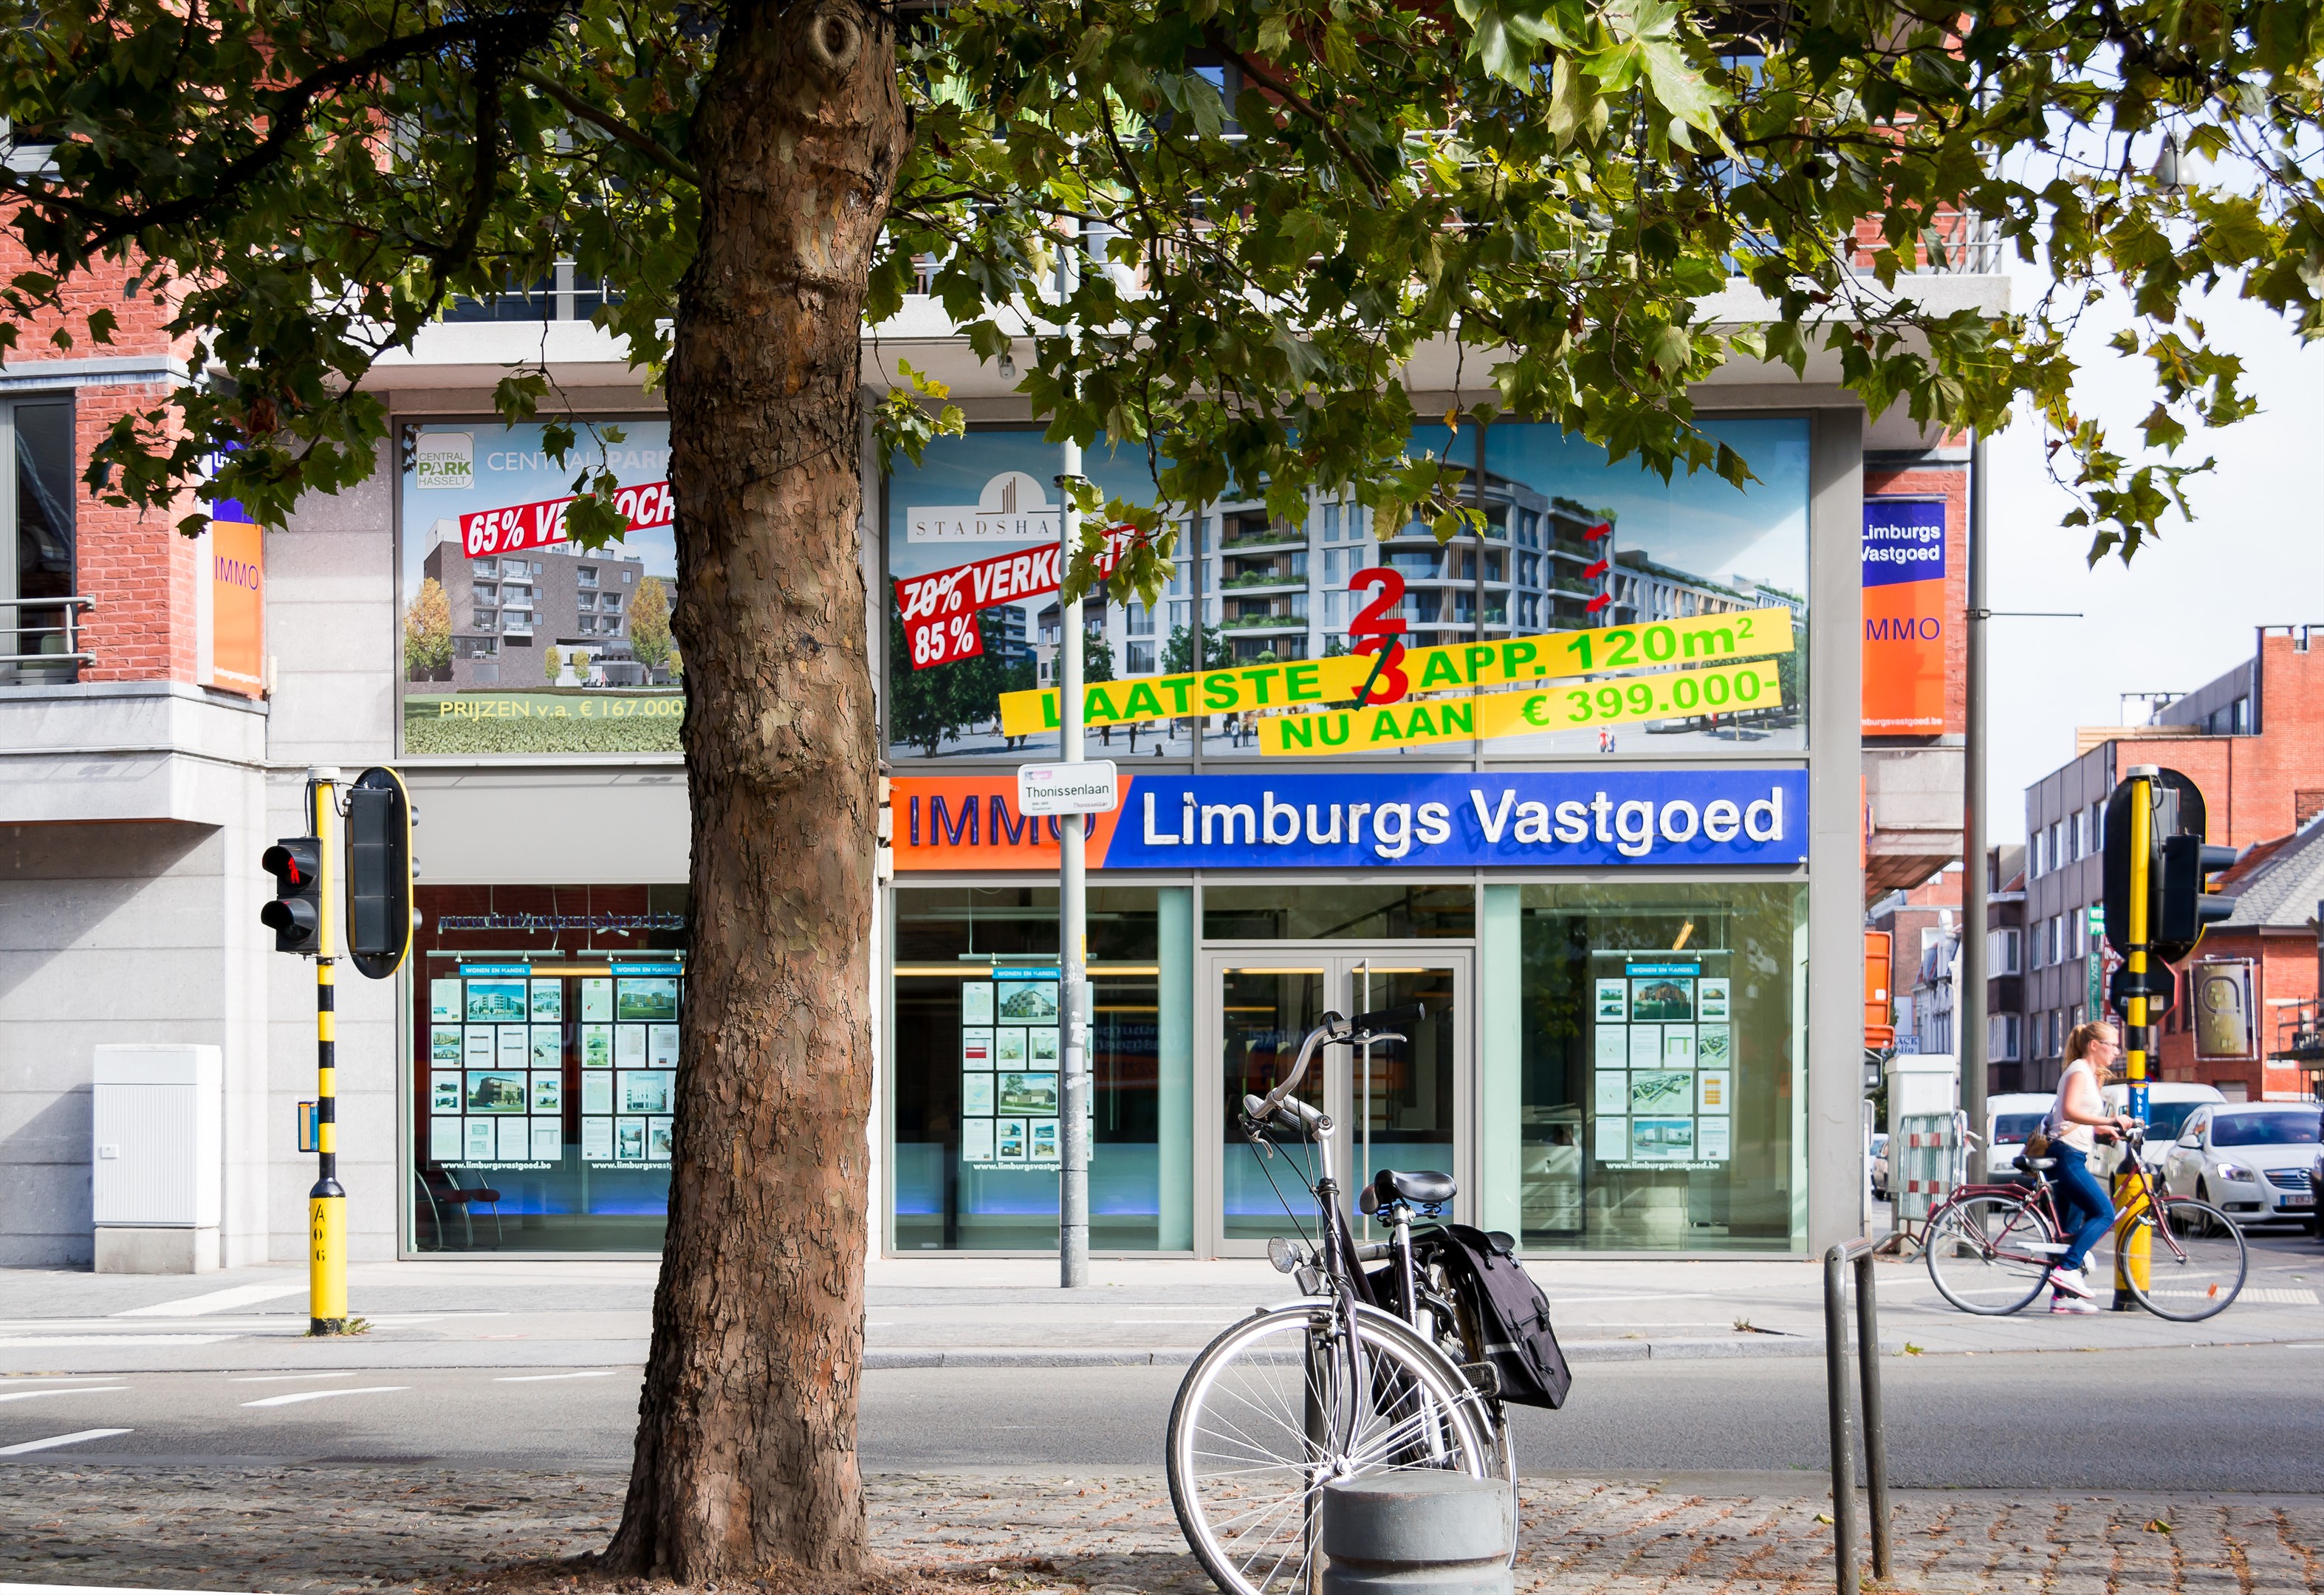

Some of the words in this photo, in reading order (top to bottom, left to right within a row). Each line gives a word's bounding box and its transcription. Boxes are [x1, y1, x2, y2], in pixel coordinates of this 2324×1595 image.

[419, 452, 466, 462] CENTRAL
[419, 462, 472, 476] PARK
[419, 476, 467, 486] HASSELT
[467, 507, 526, 555] 65%
[916, 518, 1091, 536] STADSHA
[214, 555, 259, 591] IMMO
[1348, 566, 1407, 637] 2
[1041, 664, 1323, 729] LAATSTE
[1419, 641, 1547, 688] APP.
[439, 701, 530, 722] PRIJZEN
[536, 704, 573, 717] v.a.
[578, 700, 594, 718] €
[602, 699, 685, 717] 167.000
[1280, 713, 1350, 750] NU
[1369, 702, 1474, 742] AAN
[1521, 694, 1550, 727] €
[1025, 783, 1110, 798] Thonissenlaan
[1143, 790, 1451, 859] Limburgs
[1470, 786, 1784, 857] Vastgoed
[441, 1161, 552, 1171] www.limburgsvastgoed.be
[1605, 1161, 1721, 1171] www.limburgsvastgoed.be
